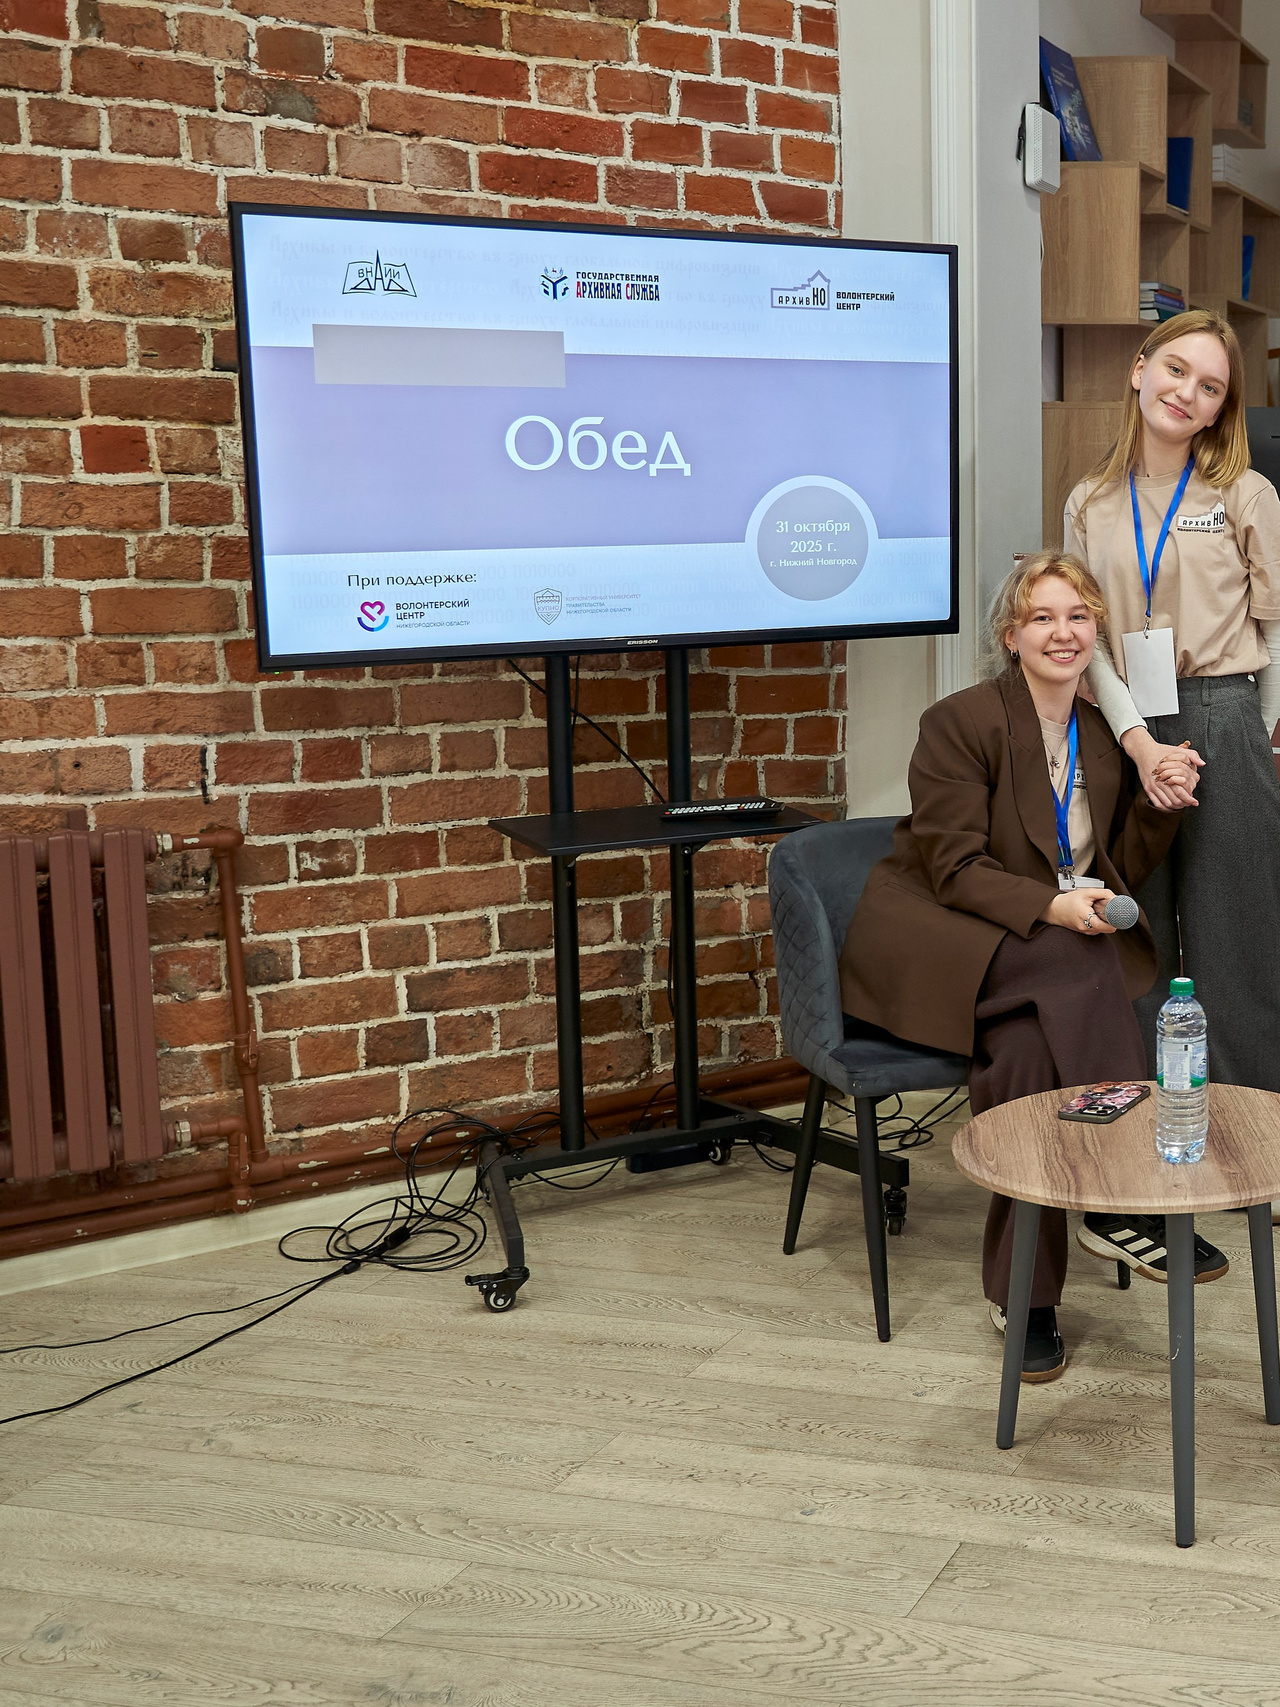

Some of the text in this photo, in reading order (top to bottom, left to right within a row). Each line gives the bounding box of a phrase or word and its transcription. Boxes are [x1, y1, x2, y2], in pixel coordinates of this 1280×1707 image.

[576, 271, 660, 283] ГОСУДАРСТВЕННАЯ
[576, 281, 660, 302] АРХИВНАЯ СЛУЖБА
[836, 291, 895, 302] ВОЛОНТЕРСКИЙ
[836, 302, 861, 311] ЦЕНТР
[505, 415, 692, 477] Обед
[775, 520, 850, 536] 31 октября
[790, 540, 837, 553] 2025 г.
[770, 557, 858, 568] г. Нижний Новгород
[347, 571, 477, 590] При поддержке:
[396, 599, 470, 611] ВОЛОНТЕРСКИЙ
[396, 611, 426, 621] ЦЕНТР
[446, 620, 471, 628] ОБЛАСТИ
